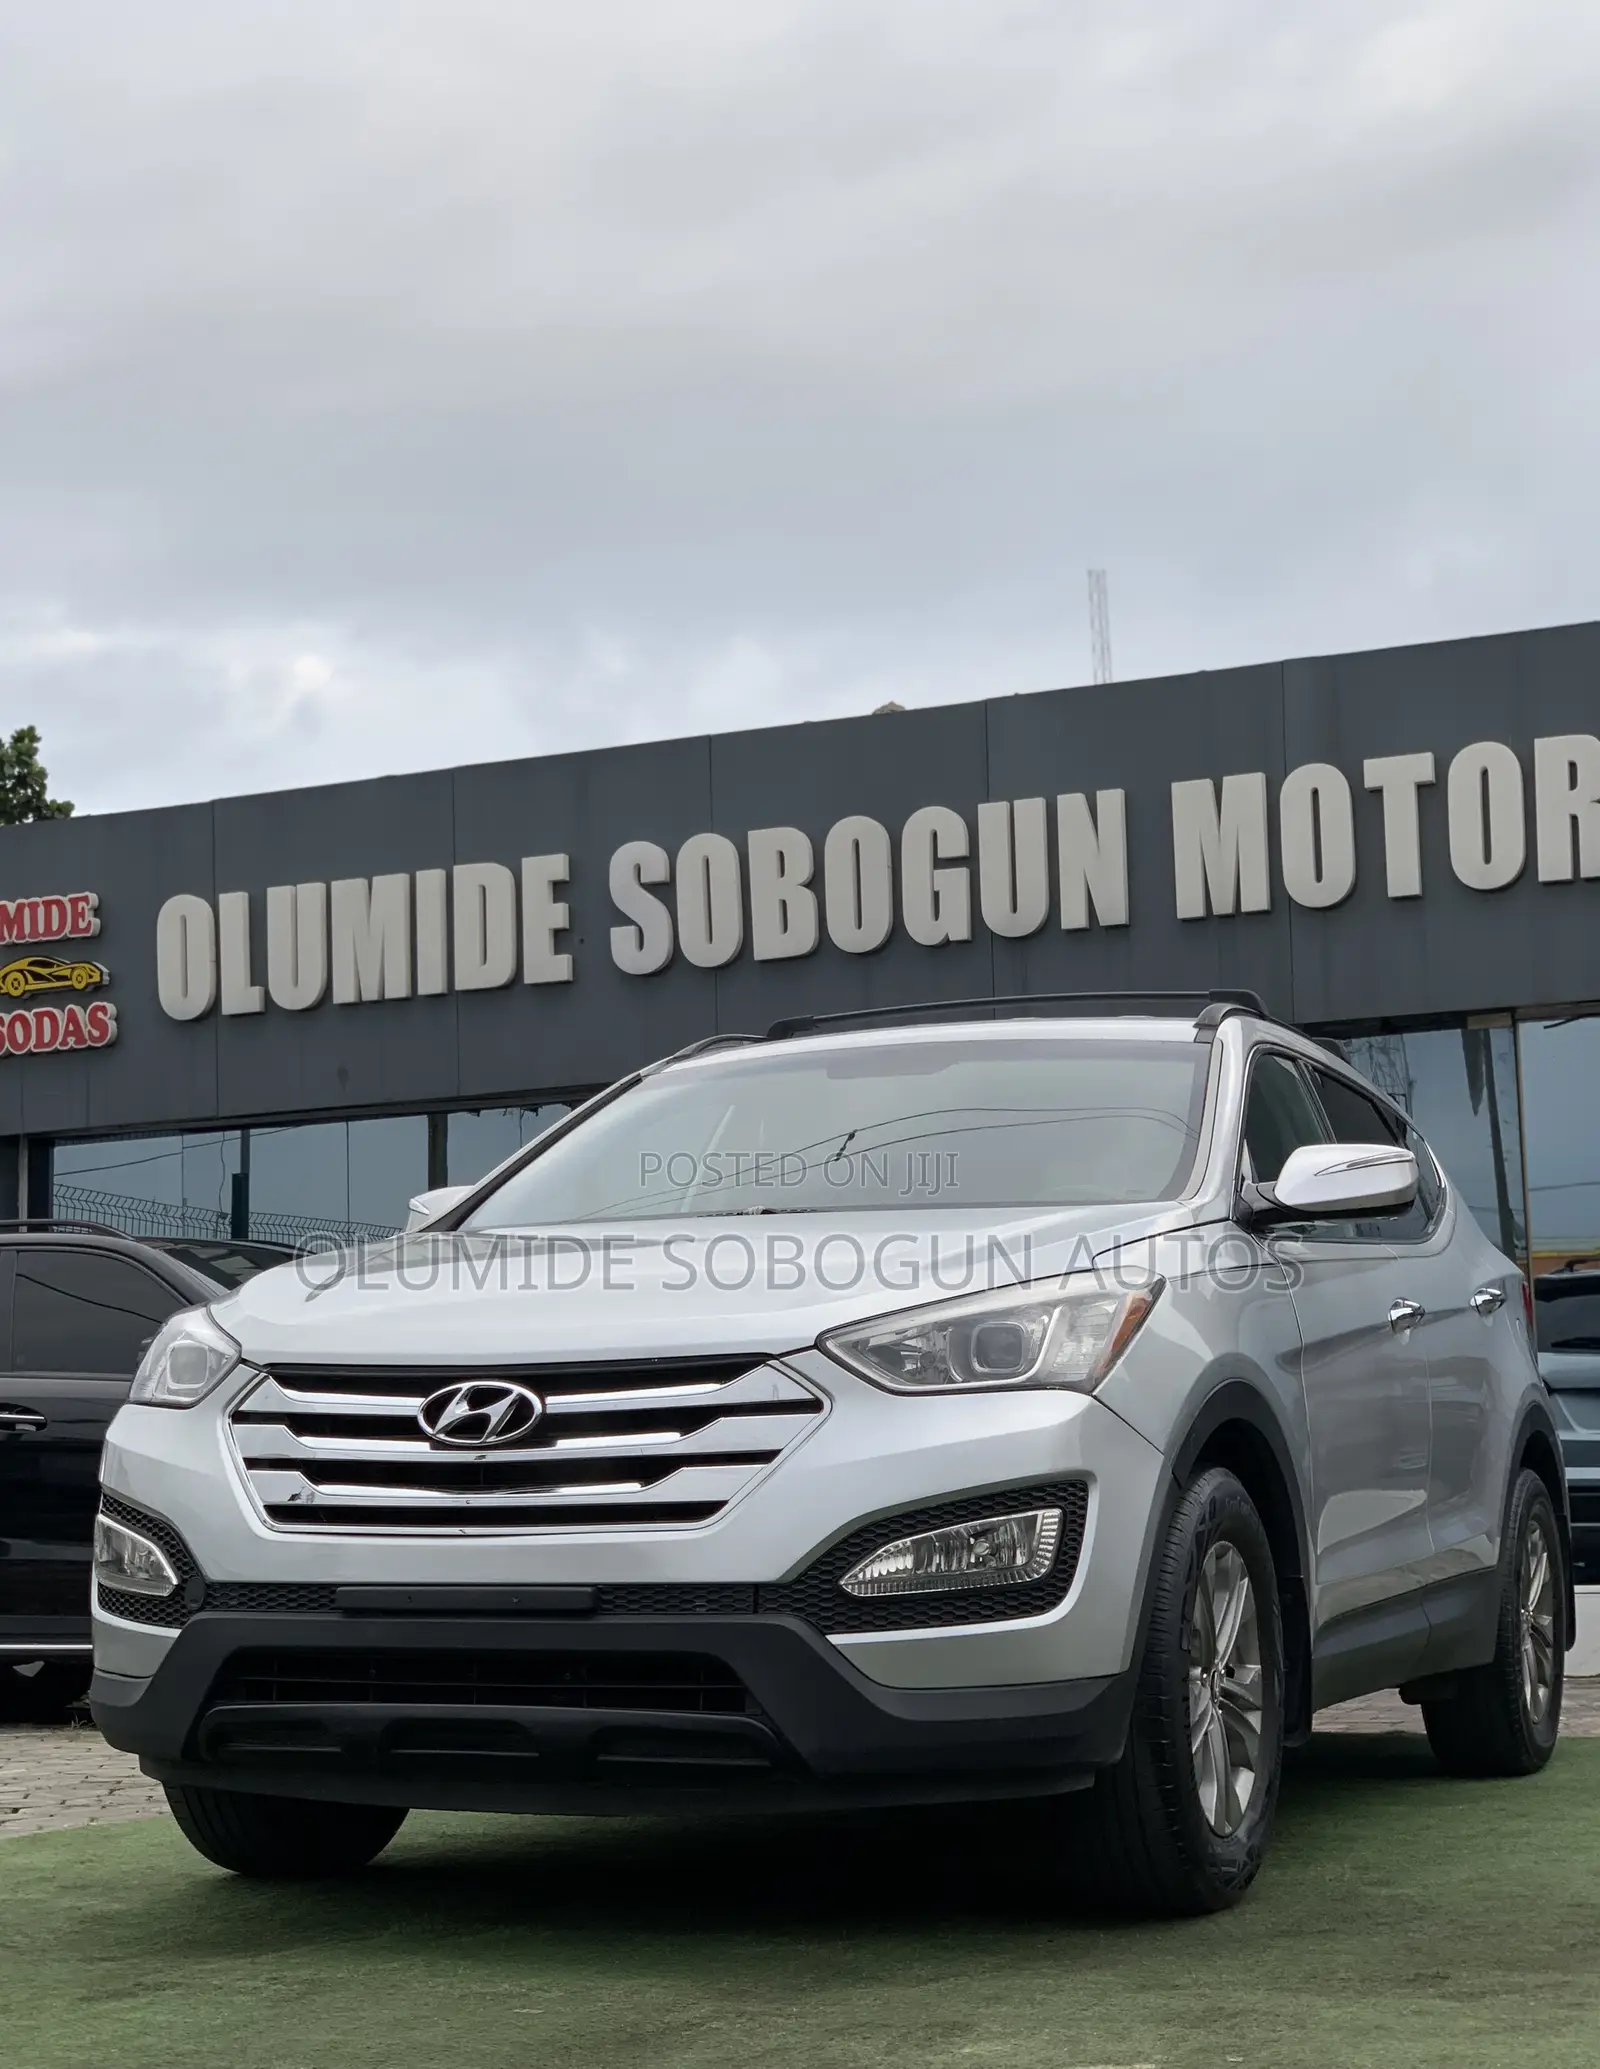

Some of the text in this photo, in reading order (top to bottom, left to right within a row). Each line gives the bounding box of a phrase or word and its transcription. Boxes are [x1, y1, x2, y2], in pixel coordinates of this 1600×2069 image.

[157, 734, 1600, 1021] OLUMIDE SOBOGUN MOTOR
[0, 1002, 115, 1056] ODAS
